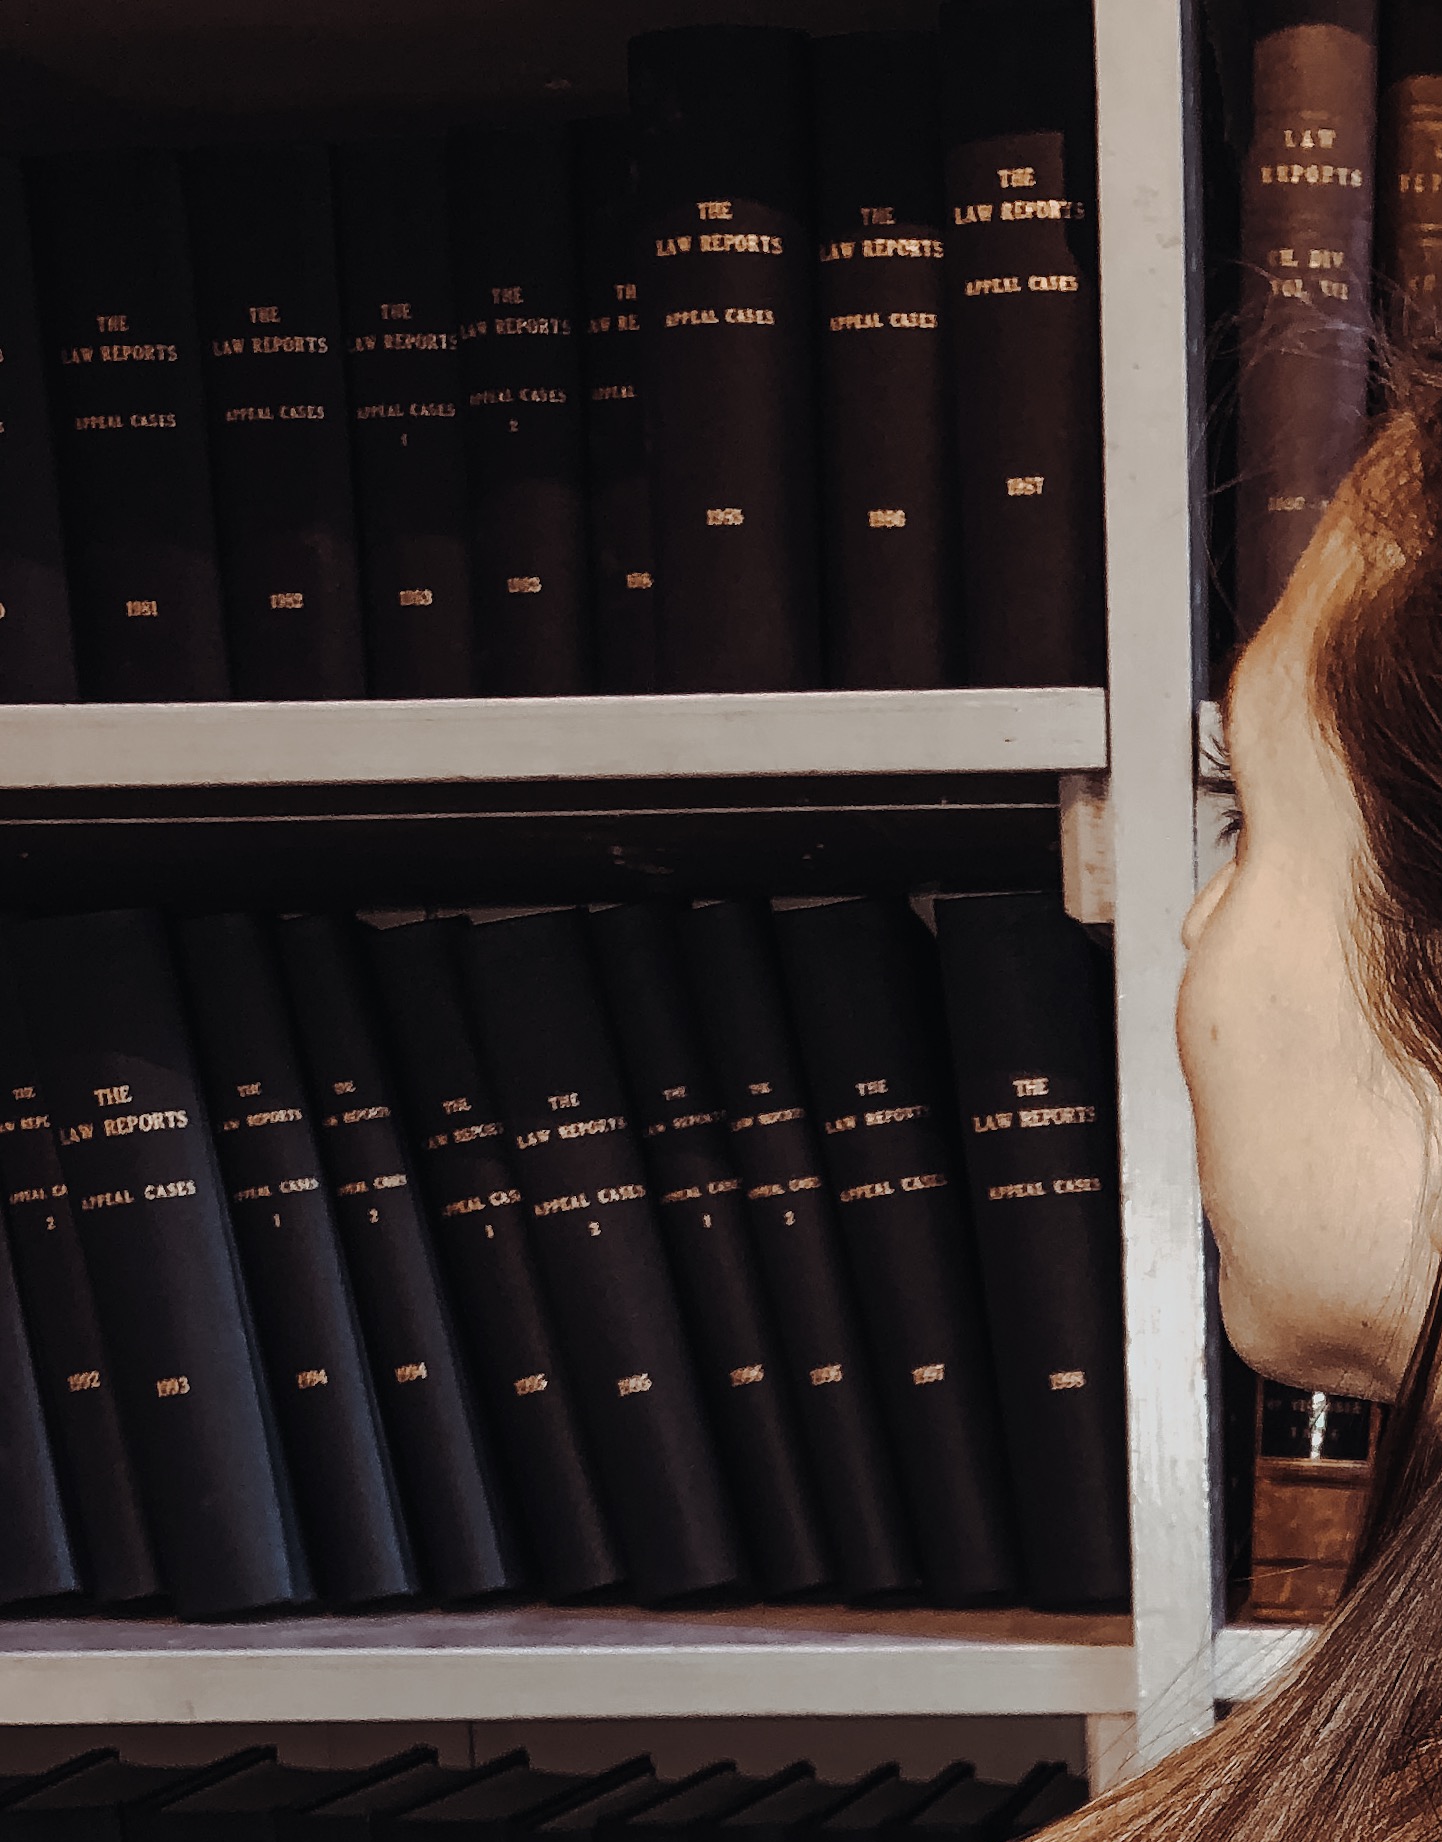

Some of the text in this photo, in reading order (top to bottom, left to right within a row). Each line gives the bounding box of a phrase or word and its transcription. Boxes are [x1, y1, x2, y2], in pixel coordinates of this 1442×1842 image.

[1284, 129, 1337, 148] LAW
[997, 167, 1036, 188] THE
[1260, 164, 1362, 188] REPORTS
[697, 201, 733, 220] THE
[861, 207, 895, 225] THE
[955, 199, 1085, 225] LAW REPORTS
[655, 234, 783, 257] LAW REPORTS
[820, 239, 944, 261] LAW REPORTS
[492, 286, 524, 304] THE
[614, 283, 637, 300] TH
[249, 306, 281, 323] THE
[381, 303, 412, 320] THE
[665, 310, 719, 327] APPEAL
[97, 315, 129, 332] THE
[100, 345, 178, 362] REPORTS
[213, 336, 328, 356] LAW REPORTS
[94, 1084, 133, 1106] THE
[855, 1078, 888, 1096] THE
[1011, 1076, 1049, 1098] THE
[547, 1092, 581, 1111] THE
[60, 1109, 189, 1146] LAW REPORTS
[825, 1115, 857, 1134] LAW
[972, 1105, 1097, 1133] LAW REPORTS
[516, 1128, 551, 1150] LAW
[557, 1115, 628, 1140] REPORTS
[144, 1179, 197, 1200] CASES
